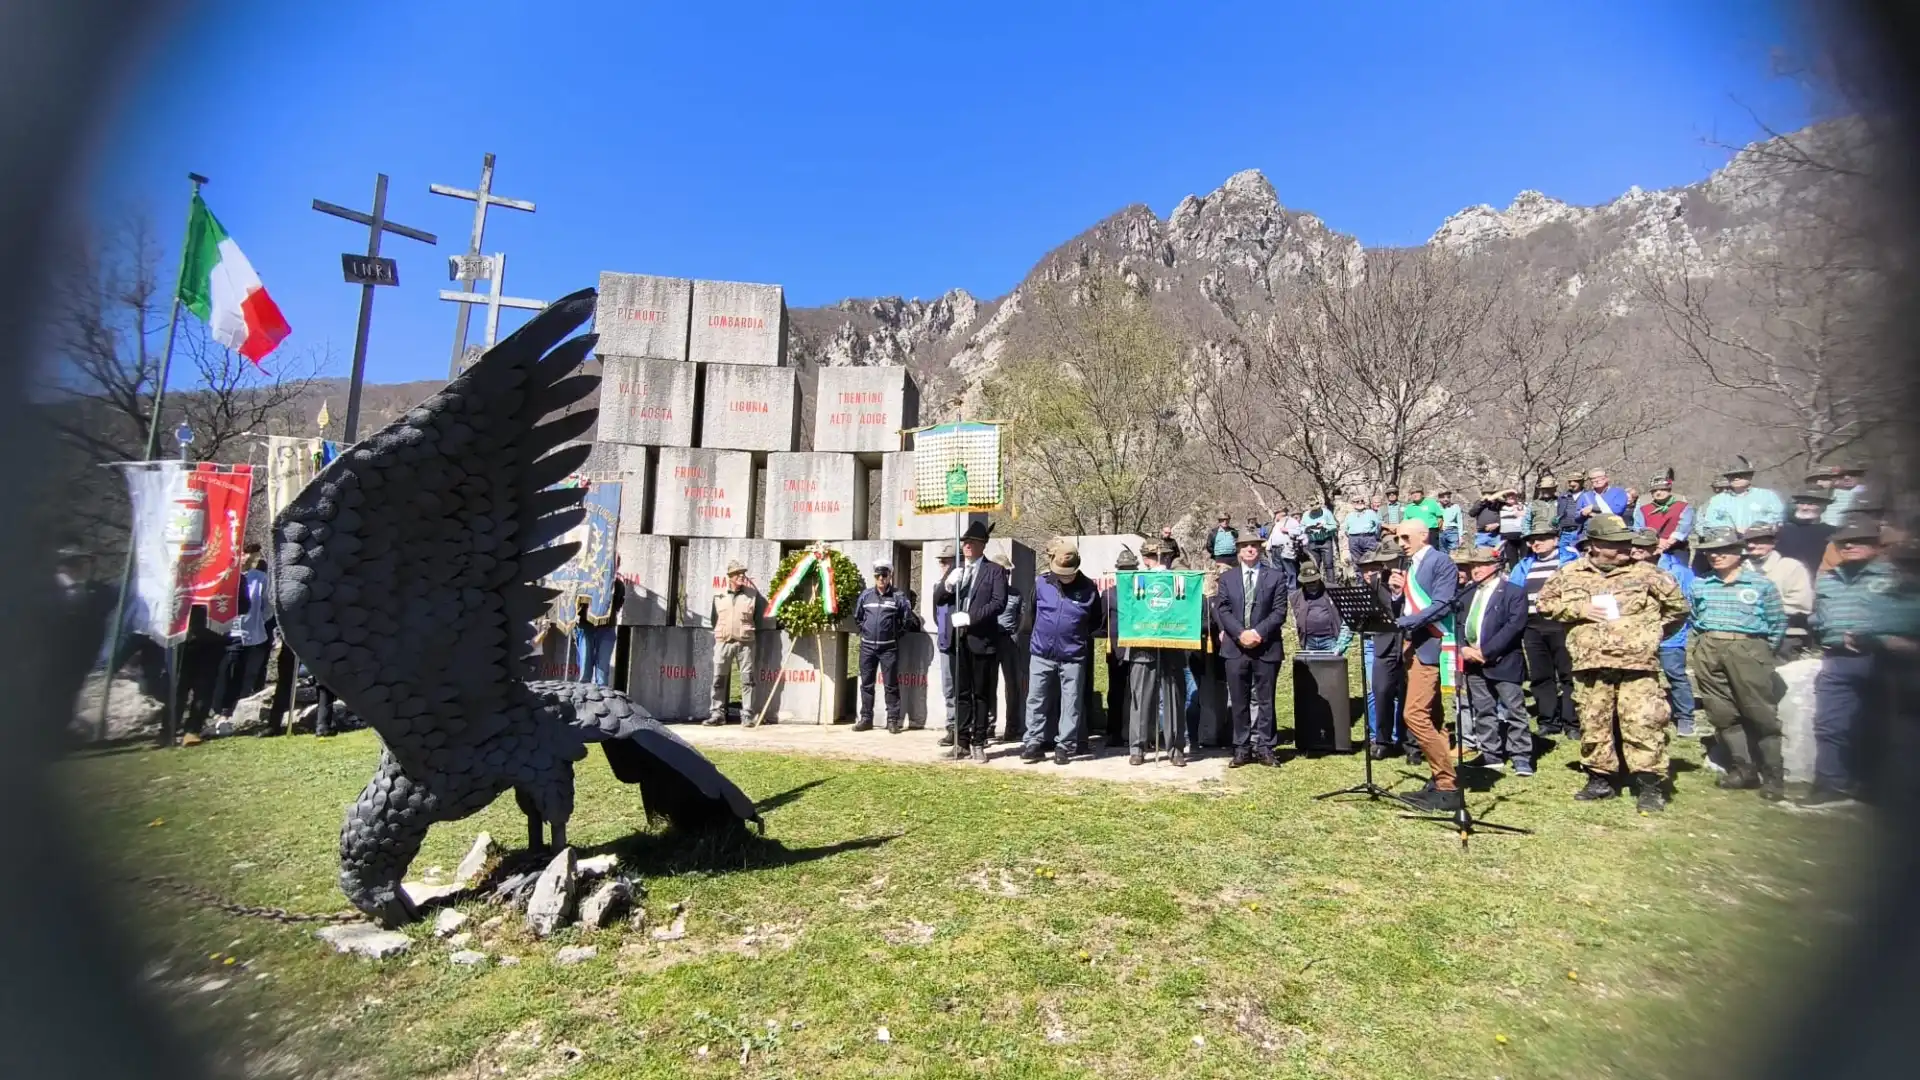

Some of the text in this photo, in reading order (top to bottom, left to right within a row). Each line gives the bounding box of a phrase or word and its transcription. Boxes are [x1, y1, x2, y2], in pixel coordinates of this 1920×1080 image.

[617, 307, 668, 323] PIEMONTE
[708, 315, 764, 329] LOMBARDIA
[618, 382, 649, 397] VALLE
[838, 391, 884, 405] TRENTINO
[729, 400, 769, 413] LIGURIA
[829, 412, 888, 425] ALTO ADIGE
[674, 465, 708, 480] FRIULI
[683, 486, 726, 500] VENEZIA
[783, 479, 817, 493] EMILIA
[696, 505, 732, 519] GIULIA
[793, 500, 841, 513] ROMAGNA
[659, 664, 697, 679] PUGLIA
[760, 668, 816, 683] BASLICATA
